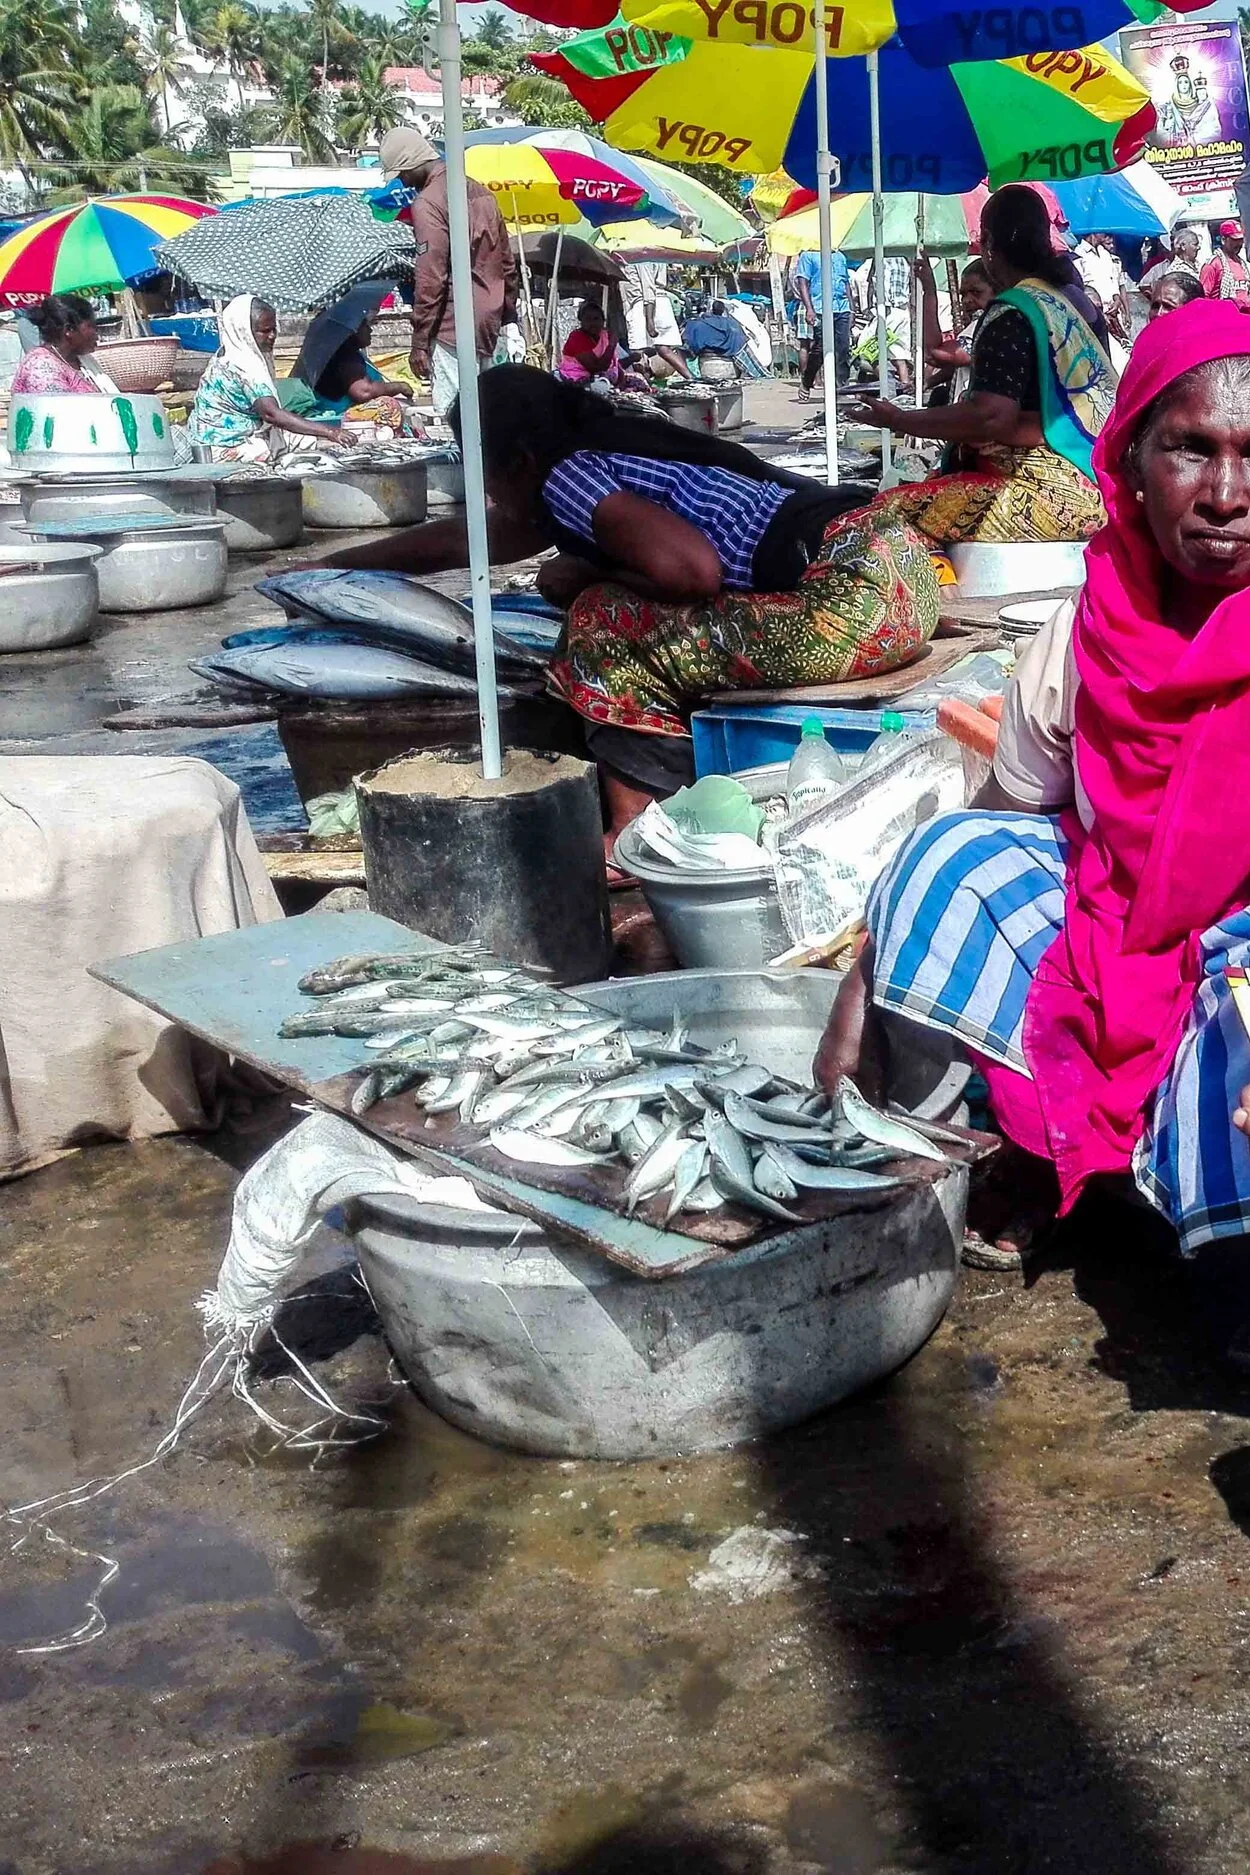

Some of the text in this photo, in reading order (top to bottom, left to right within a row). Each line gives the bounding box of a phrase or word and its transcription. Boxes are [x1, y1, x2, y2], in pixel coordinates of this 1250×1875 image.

[604, 23, 673, 71] POP
[1025, 49, 1106, 93] OPY
[486, 179, 533, 191] OPY
[573, 178, 626, 200] POPY
